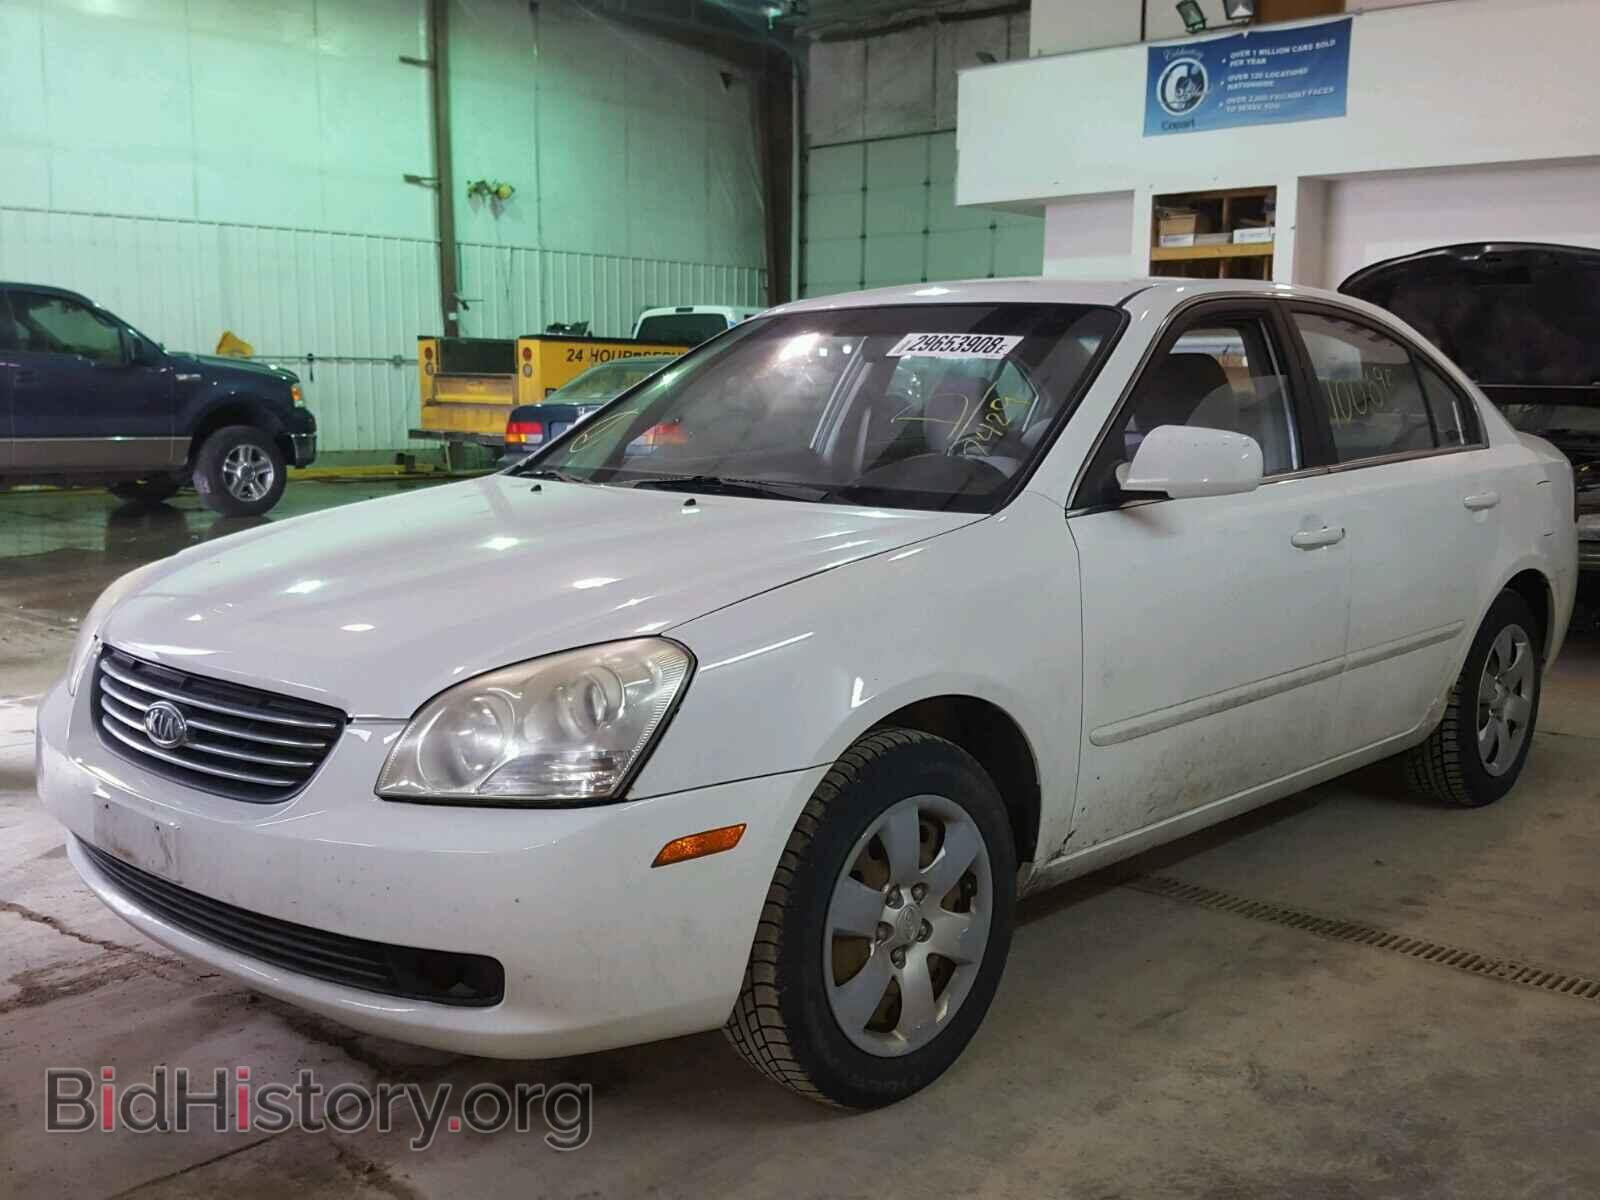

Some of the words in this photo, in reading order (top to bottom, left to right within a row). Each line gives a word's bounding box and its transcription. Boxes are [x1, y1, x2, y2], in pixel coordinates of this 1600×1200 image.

[1230, 49, 1251, 59] OVER
[1258, 47, 1290, 57] MILLION
[1291, 43, 1314, 53] CARS
[1314, 39, 1336, 50] SOLD
[1229, 58, 1245, 67] PER
[1246, 58, 1267, 66] YEAR
[1227, 73, 1249, 82] OVER
[1264, 66, 1309, 79] LOCATIONS
[907, 334, 1005, 354] 29653908
[565, 348, 584, 363] 24
